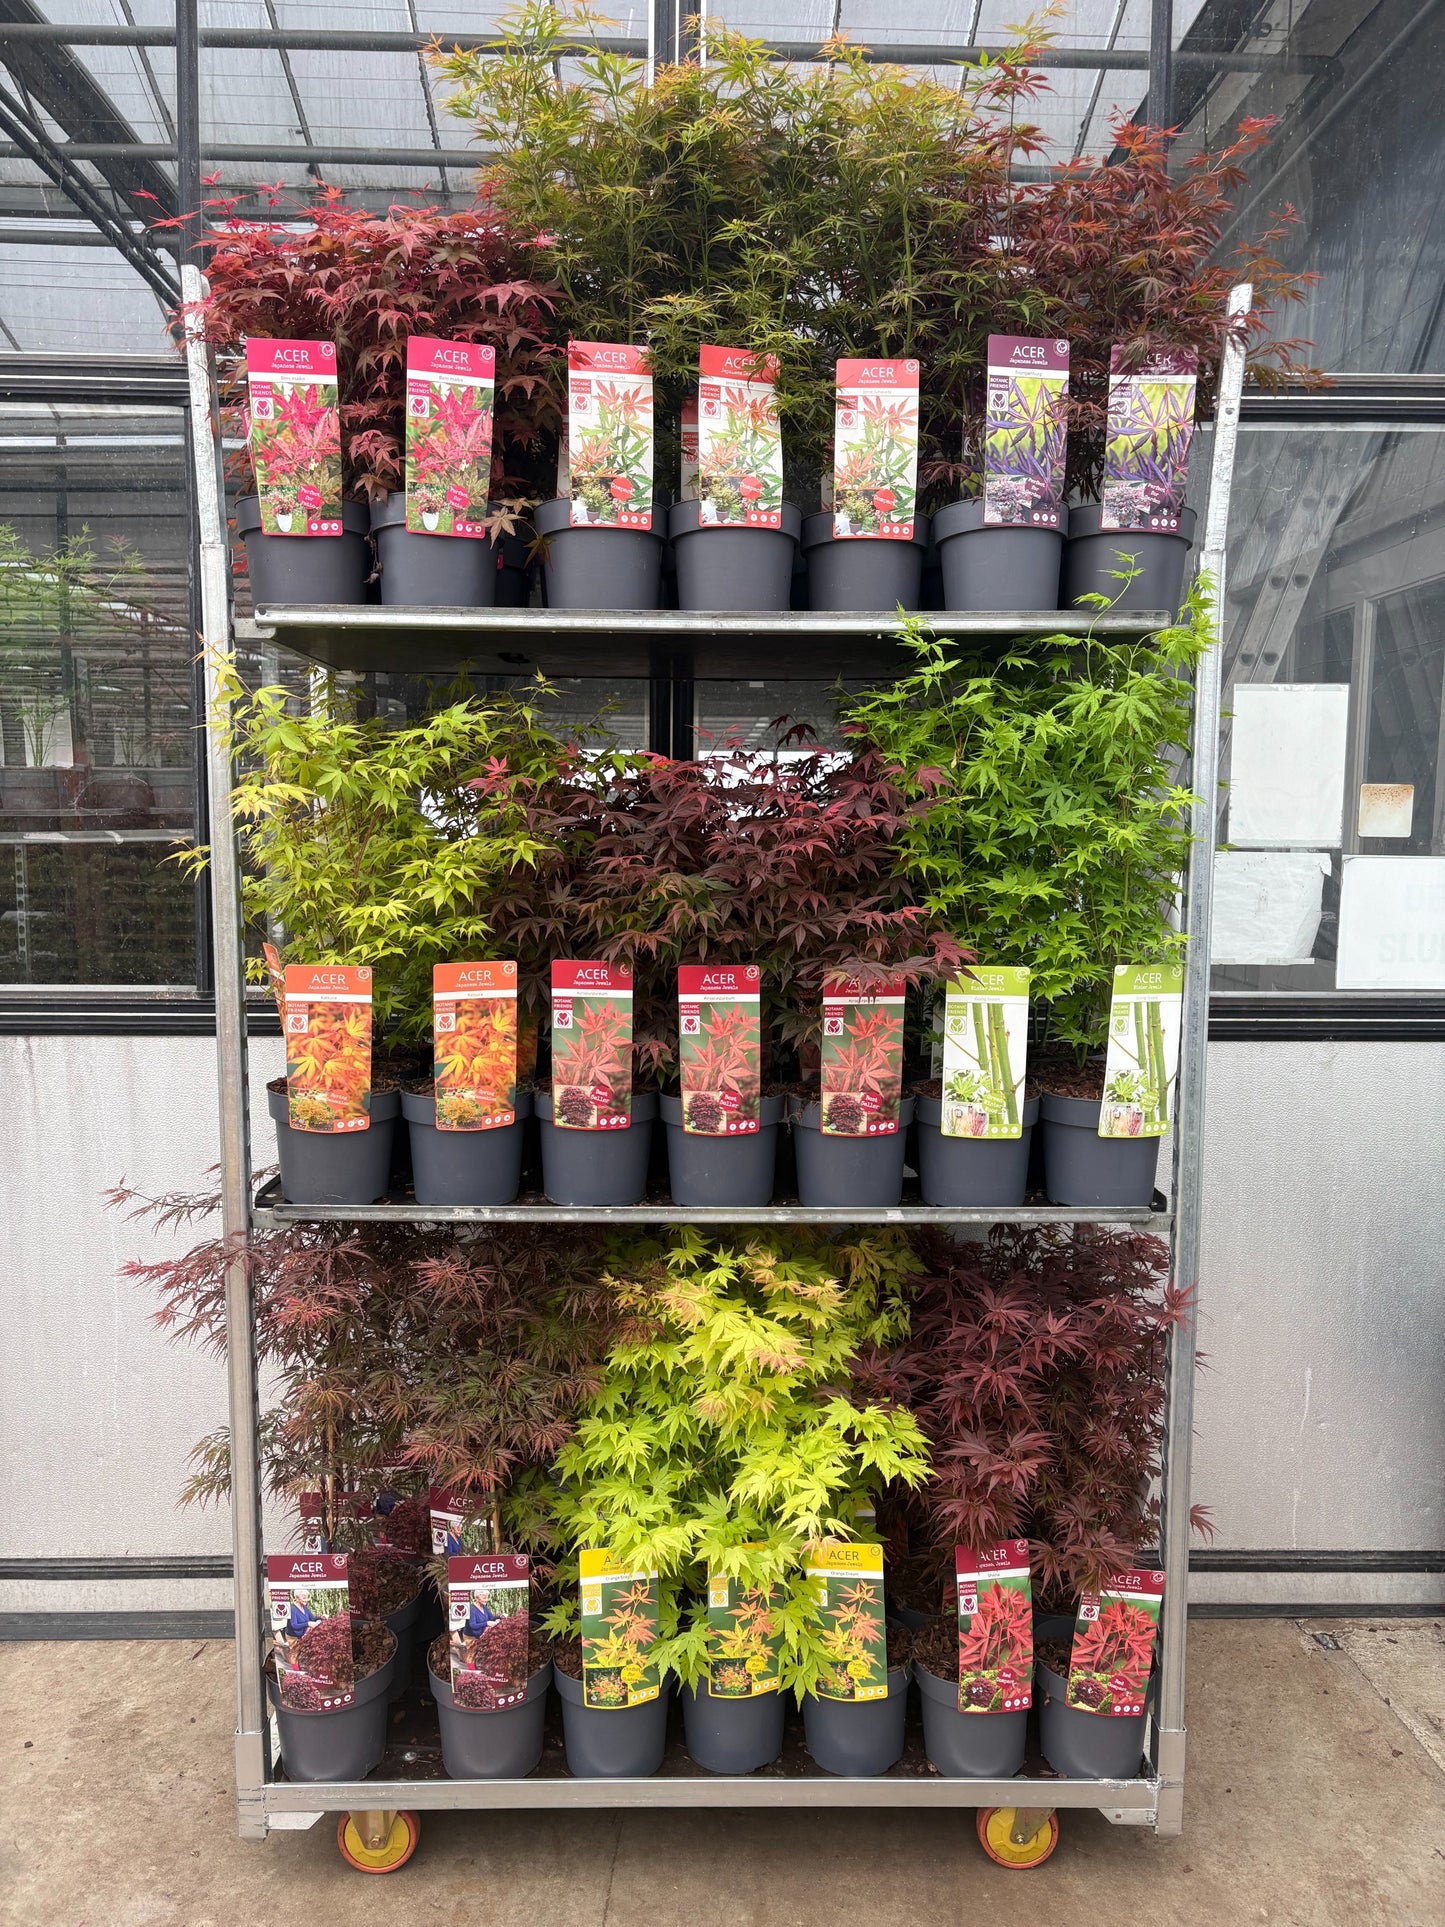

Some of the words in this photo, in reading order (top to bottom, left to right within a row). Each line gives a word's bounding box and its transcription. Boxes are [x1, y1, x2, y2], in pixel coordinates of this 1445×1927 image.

[274, 349, 310, 362] ACER
[434, 349, 469, 364] ACER
[1013, 345, 1044, 358] ACER
[594, 351, 627, 364] ACER
[1144, 354, 1171, 365] CER
[862, 368, 894, 378] ACER
[1028, 478, 1046, 488] Perfect
[1147, 482, 1166, 492] Perfect
[301, 486, 320, 496] Perfect
[450, 486, 468, 498] Perfect
[610, 484, 633, 493] Compact
[459, 970, 492, 982] ACER
[576, 968, 608, 979] ACER
[1135, 972, 1162, 984] ACER
[312, 974, 346, 984] ACER
[702, 974, 734, 984] ACER
[591, 1094, 609, 1103] Seller
[720, 1099, 738, 1108] Seller
[861, 1100, 879, 1109] Seller
[829, 1550, 859, 1560] ACER
[292, 1562, 323, 1572] ACER
[472, 1563, 504, 1573] ACER
[1110, 1574, 1140, 1585] ACER
[996, 1677, 1014, 1685] Compact
[1108, 1682, 1127, 1692] Compact
